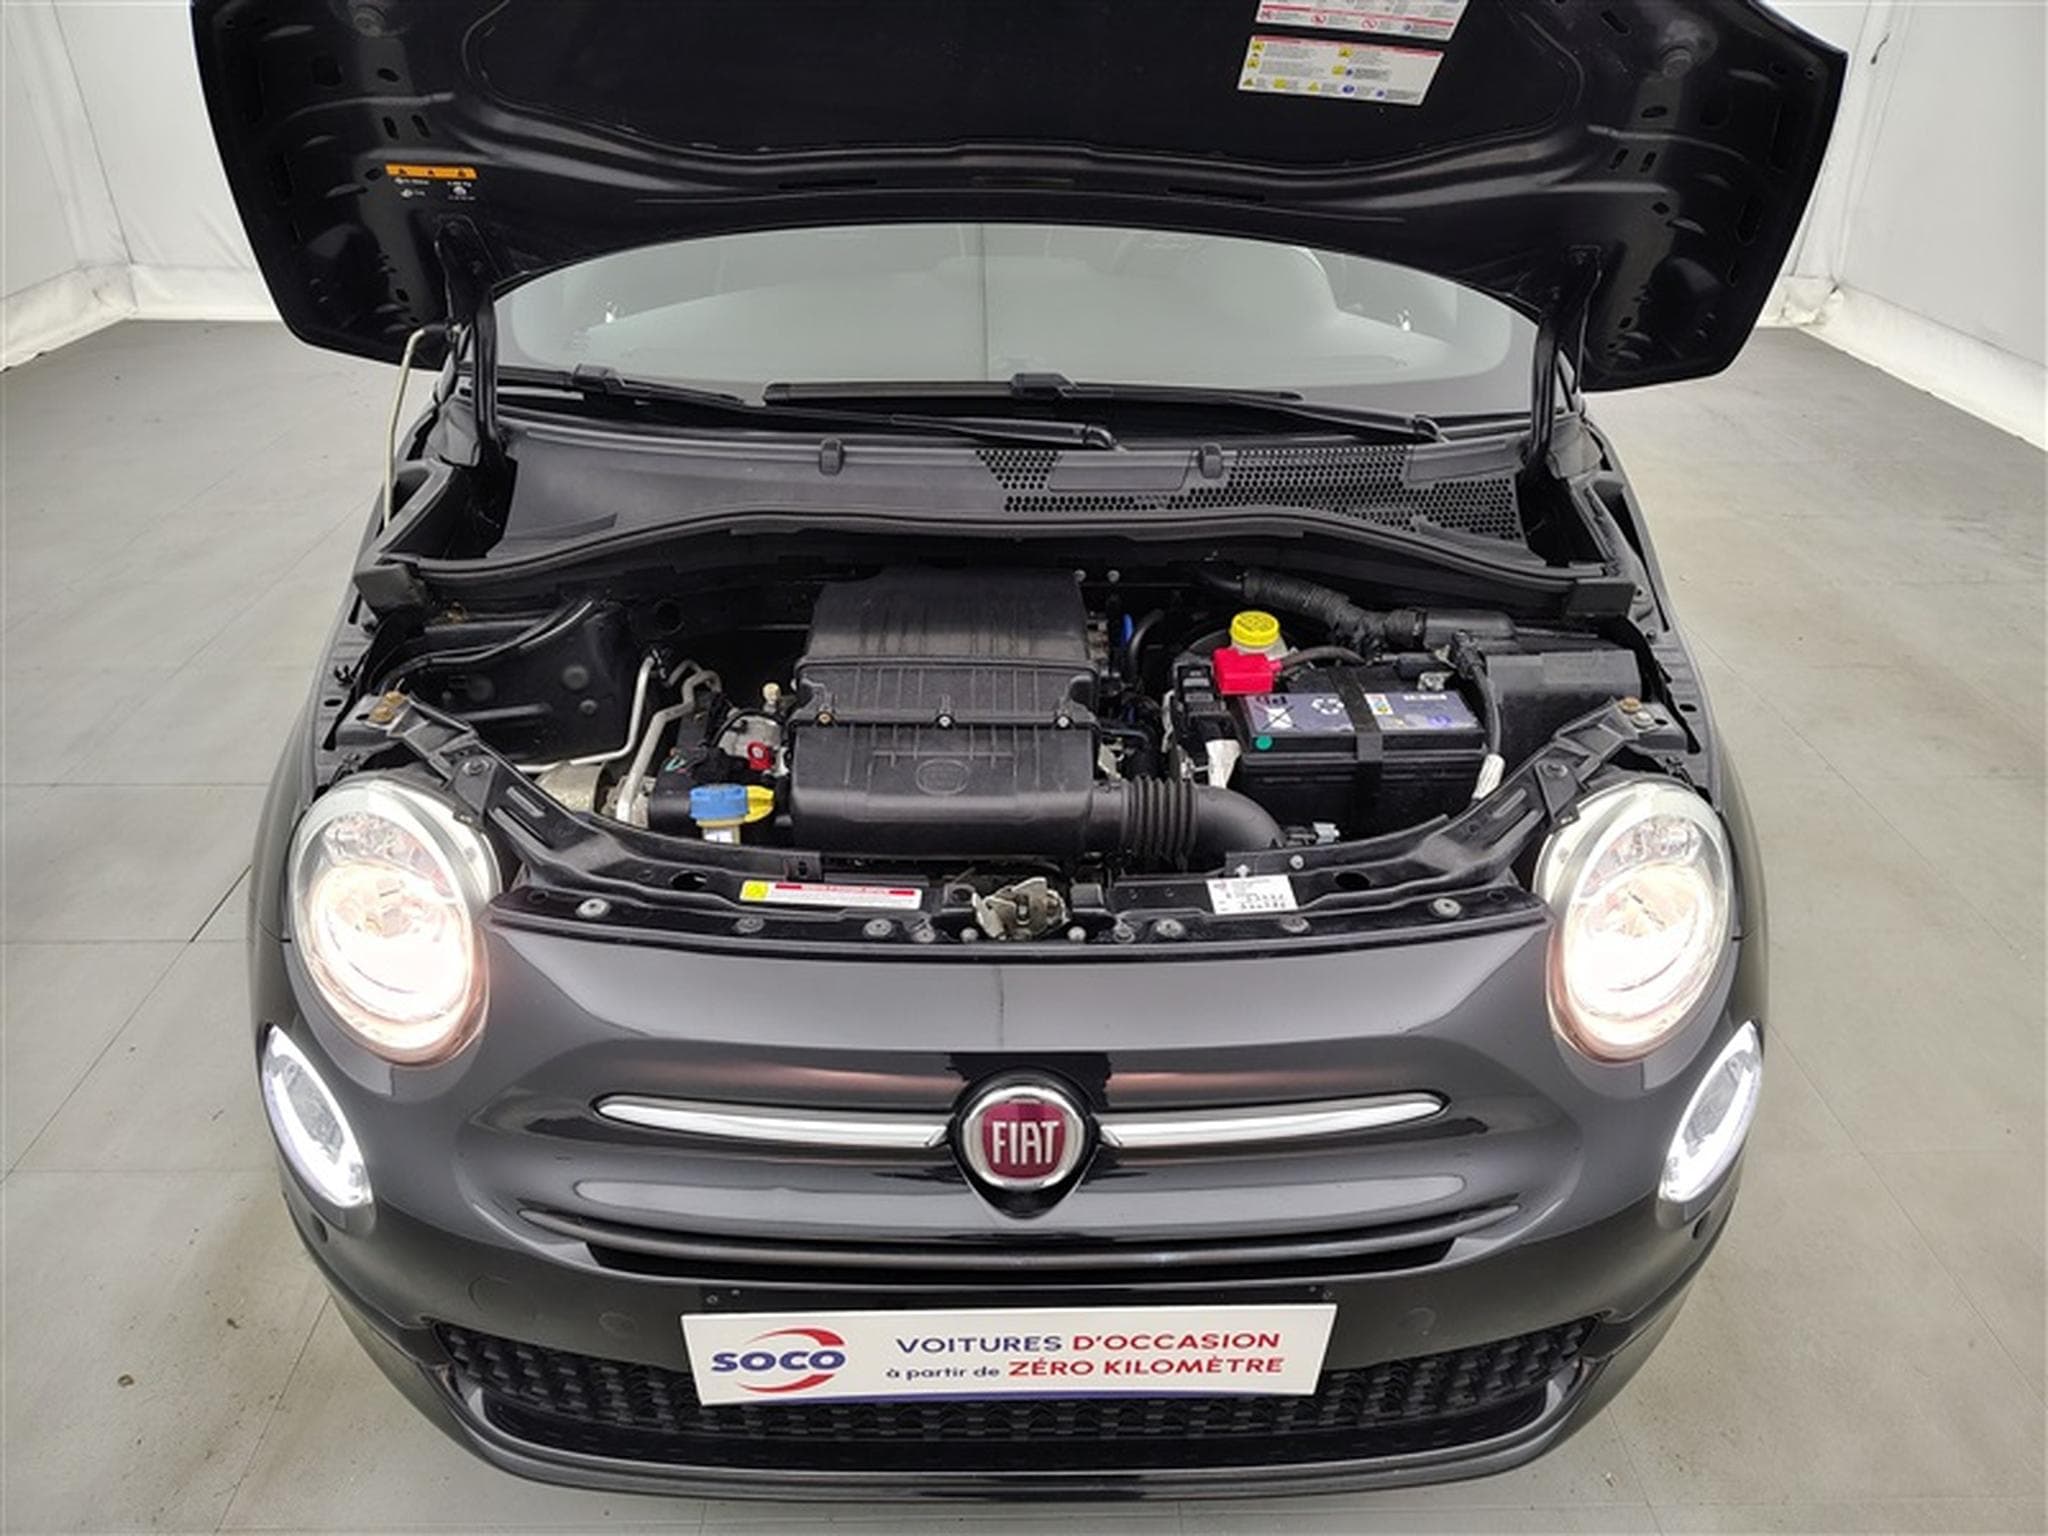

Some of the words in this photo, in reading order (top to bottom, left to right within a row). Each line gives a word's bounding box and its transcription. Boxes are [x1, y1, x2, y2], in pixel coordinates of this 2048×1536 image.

[992, 1120, 1060, 1165] FIAT
[896, 1336, 1063, 1353] VOITURES
[1073, 1333, 1280, 1351] D'OCCASION
[711, 1350, 846, 1372] SOCO
[886, 1365, 899, 1378] à
[906, 1366, 967, 1381] partir
[973, 1366, 1000, 1378] de
[1008, 1357, 1095, 1376] ZÉRO
[1104, 1355, 1285, 1375] KILOMÈTRE
